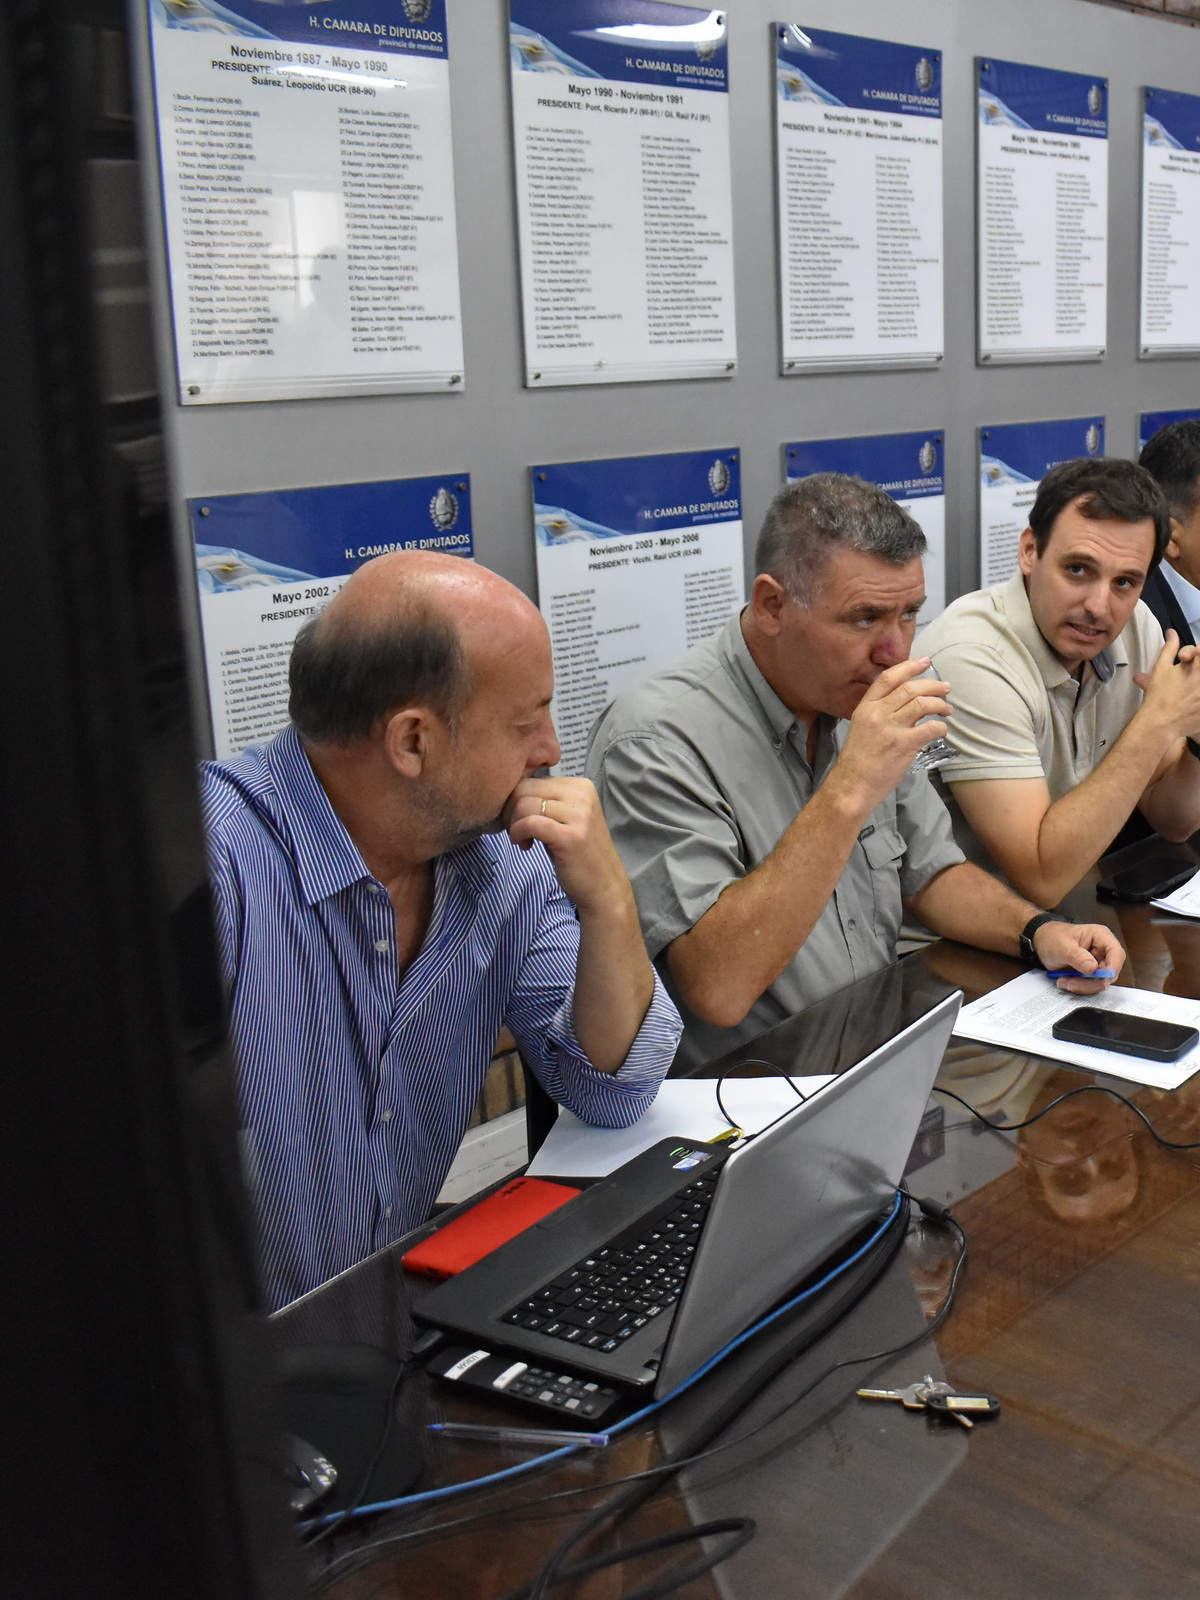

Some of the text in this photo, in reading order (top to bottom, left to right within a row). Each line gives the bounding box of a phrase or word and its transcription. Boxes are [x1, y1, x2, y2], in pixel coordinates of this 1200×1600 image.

[309, 16, 443, 42] H. CAMARA DE DIPUTADOS
[379, 39, 407, 48] provincia
[417, 43, 443, 52] mendoza
[211, 60, 273, 75] PRESIDENTE:
[230, 45, 293, 62] Noviembre
[297, 53, 321, 65] 1987
[332, 56, 360, 71] Mayo
[364, 59, 388, 72] 1990
[625, 57, 725, 79] H. CAMARA DE DIPUTADOS
[251, 76, 376, 97] Suárez, Leopoldo UCR (88-90)
[568, 84, 591, 97] Mayo
[594, 87, 613, 98] 1990
[621, 89, 664, 103] Noviembre
[666, 95, 683, 104] 1991
[871, 89, 898, 100] CAMARA
[899, 93, 907, 102] DE
[908, 94, 939, 107] DIPUTADOS
[537, 98, 584, 110] PRESIDENTE:
[585, 103, 602, 113] Pont,
[604, 105, 628, 114] Ricardo
[630, 107, 638, 115] PJ
[691, 113, 698, 121] PJ
[824, 113, 855, 124] Noviembre
[873, 118, 888, 128] Mayo
[644, 499, 738, 519] H. CAMARA DE DIPUTADOS
[345, 534, 470, 559] H. CAMARA DE DIPUTADOS
[590, 543, 633, 556] Noviembre
[635, 540, 653, 550] 2003
[660, 537, 680, 547] Mayo
[682, 533, 699, 543] 2006
[653, 553, 667, 561] Raúl
[669, 551, 682, 559] UCR
[272, 590, 302, 604] Mayo
[305, 586, 329, 599] 2002
